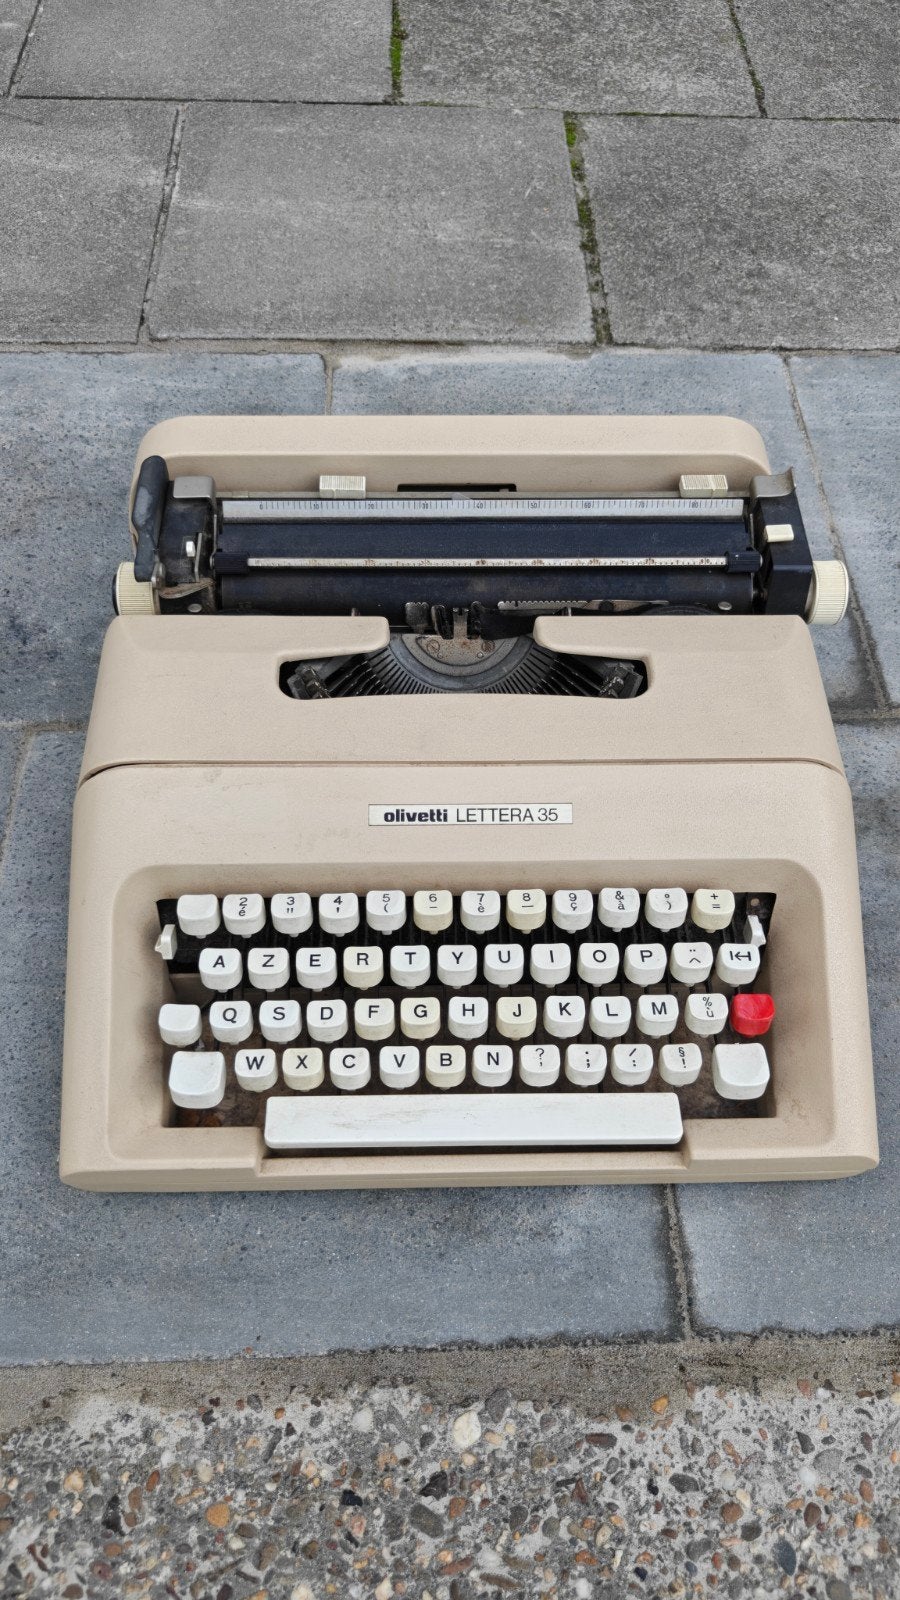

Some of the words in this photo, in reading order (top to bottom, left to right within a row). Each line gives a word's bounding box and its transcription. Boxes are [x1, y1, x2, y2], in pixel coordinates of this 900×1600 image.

[383, 808, 448, 823] olivetti
[456, 808, 534, 823] LETTERA
[538, 808, 558, 822] 35
[239, 897, 248, 906] 2
[286, 896, 295, 906] 3
[333, 896, 343, 905] 4
[382, 894, 390, 902] 5
[429, 894, 438, 902] 6
[477, 893, 485, 902] 7
[522, 892, 531, 902] 8
[568, 892, 577, 902] 9
[615, 891, 624, 900] &
[239, 906, 246, 916] é
[478, 903, 484, 912] è
[571, 903, 577, 911] ç
[212, 955, 225, 968] A
[262, 954, 275, 968] Z
[309, 954, 321, 967] E
[356, 952, 369, 966] R
[404, 952, 416, 965] T
[452, 952, 464, 964] Y
[498, 950, 511, 964] U
[549, 950, 554, 963] I
[592, 949, 607, 963] O
[640, 950, 653, 962] P
[703, 997, 712, 1006] %
[272, 1006, 286, 1021] S
[320, 1006, 334, 1020] D
[368, 1005, 380, 1018] F
[414, 1004, 428, 1018] G
[462, 1003, 475, 1017] H
[512, 1003, 522, 1018] J
[558, 1002, 572, 1016] K
[606, 1003, 618, 1016] L
[651, 1002, 667, 1015] M
[707, 1007, 714, 1017] ù
[222, 1008, 237, 1024] Q
[536, 1048, 544, 1060] ?
[679, 1047, 685, 1057] §
[245, 1055, 265, 1070] W
[296, 1055, 308, 1069] X
[342, 1054, 356, 1069] C
[393, 1054, 406, 1068] V
[440, 1052, 452, 1067] B
[487, 1052, 500, 1066] N
